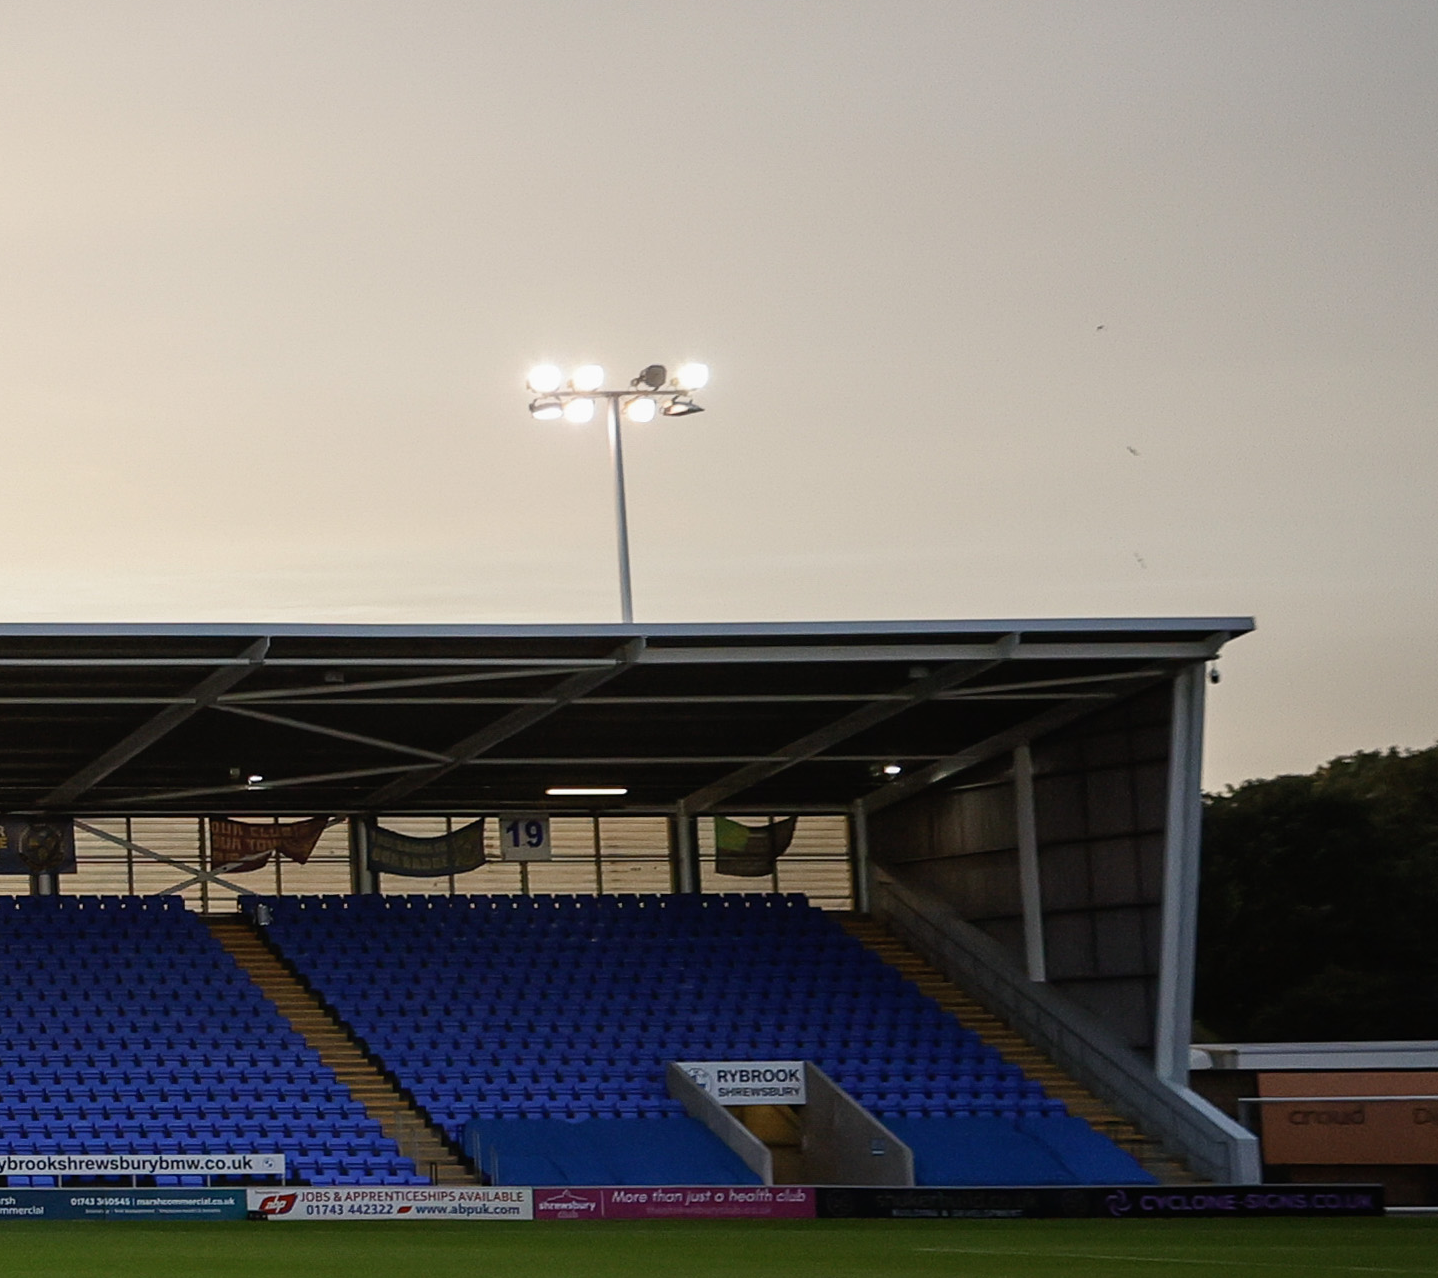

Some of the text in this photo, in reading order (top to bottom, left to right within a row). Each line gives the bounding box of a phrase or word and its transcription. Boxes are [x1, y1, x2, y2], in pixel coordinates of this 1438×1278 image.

[506, 821, 544, 848] 19
[717, 1069, 800, 1083] RYBROOK
[718, 1087, 800, 1097] SHREWSBURY
[70, 1197, 95, 1206] 01743
[299, 1190, 524, 1203] JOBS & APPRENTICESHIPS AVAILABLE
[611, 1188, 806, 1206] More than just a health club
[306, 1202, 520, 1218] 01743 442322 www.abpuk.com
[538, 1200, 596, 1212] shrewsbury
